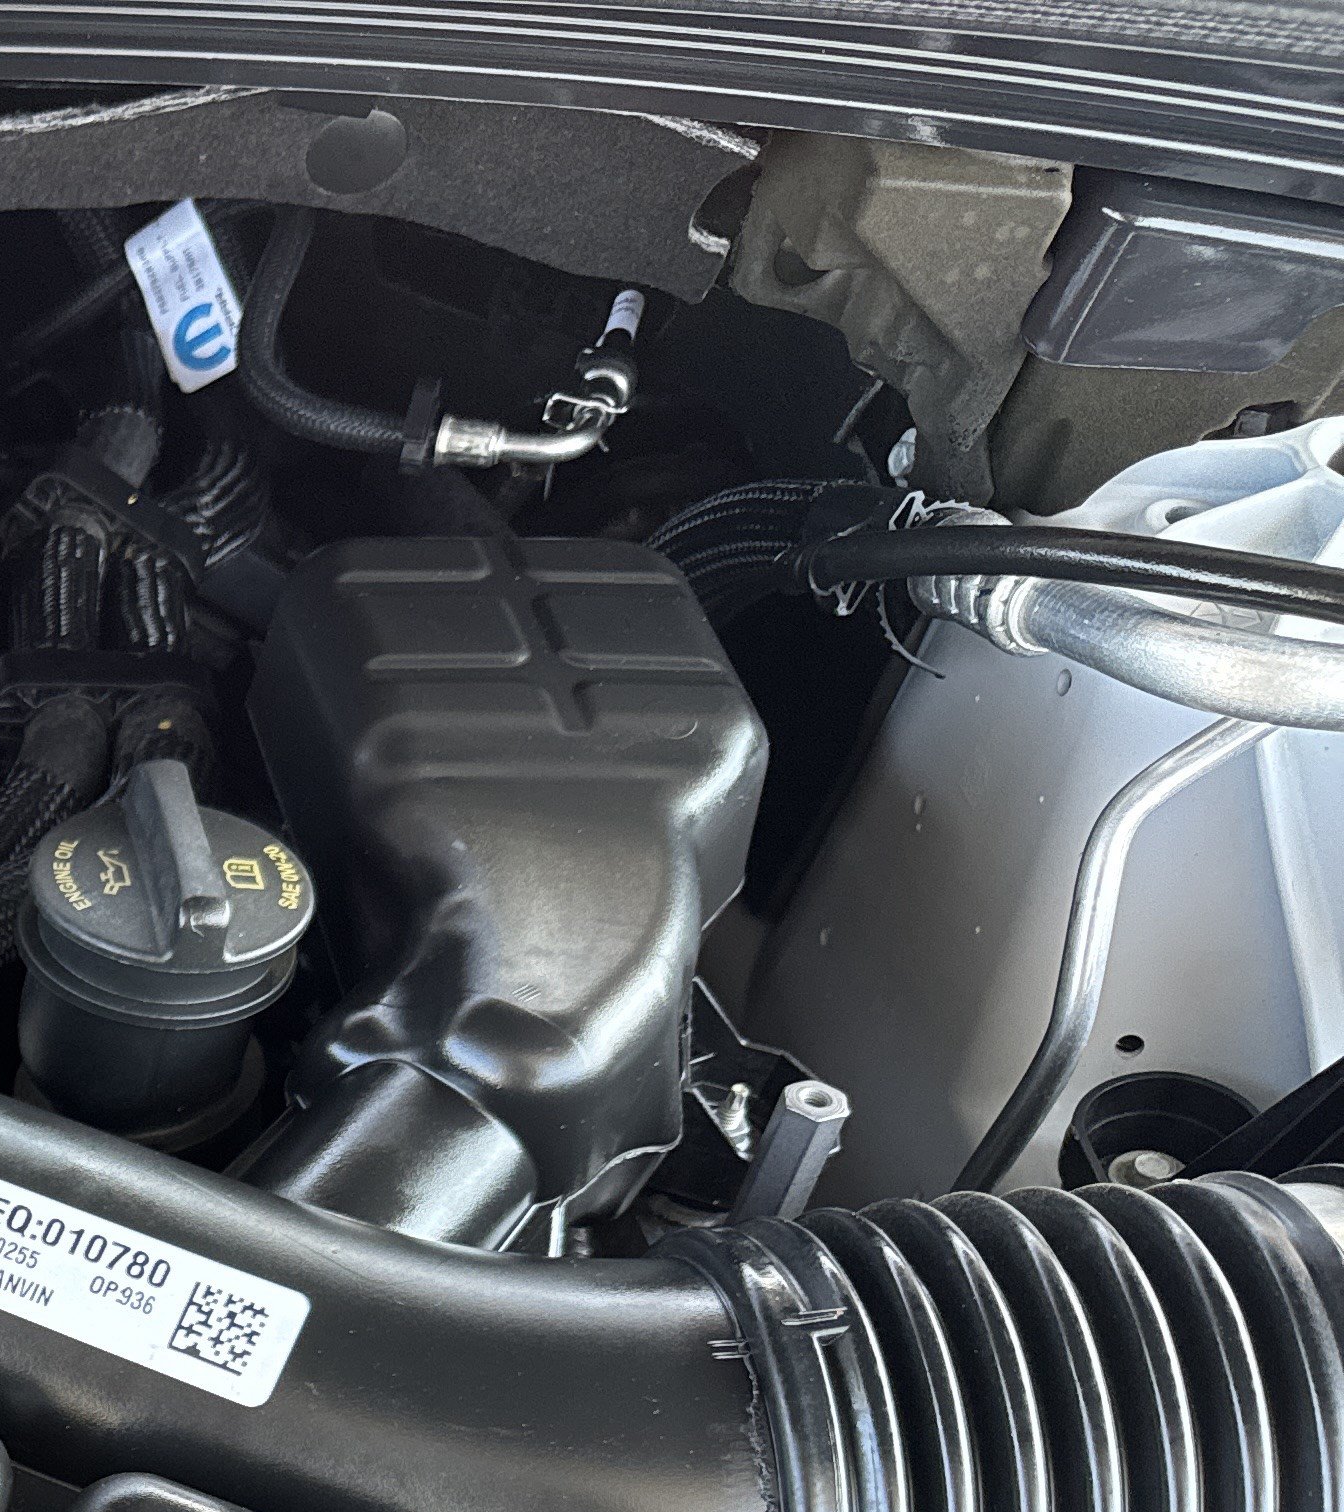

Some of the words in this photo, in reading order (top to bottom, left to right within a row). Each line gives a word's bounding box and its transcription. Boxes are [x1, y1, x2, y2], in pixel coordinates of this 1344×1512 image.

[54, 839, 79, 860] OIL
[262, 843, 302, 882] 0W-20
[52, 861, 92, 911] ENGINE
[277, 882, 301, 910] SAE
